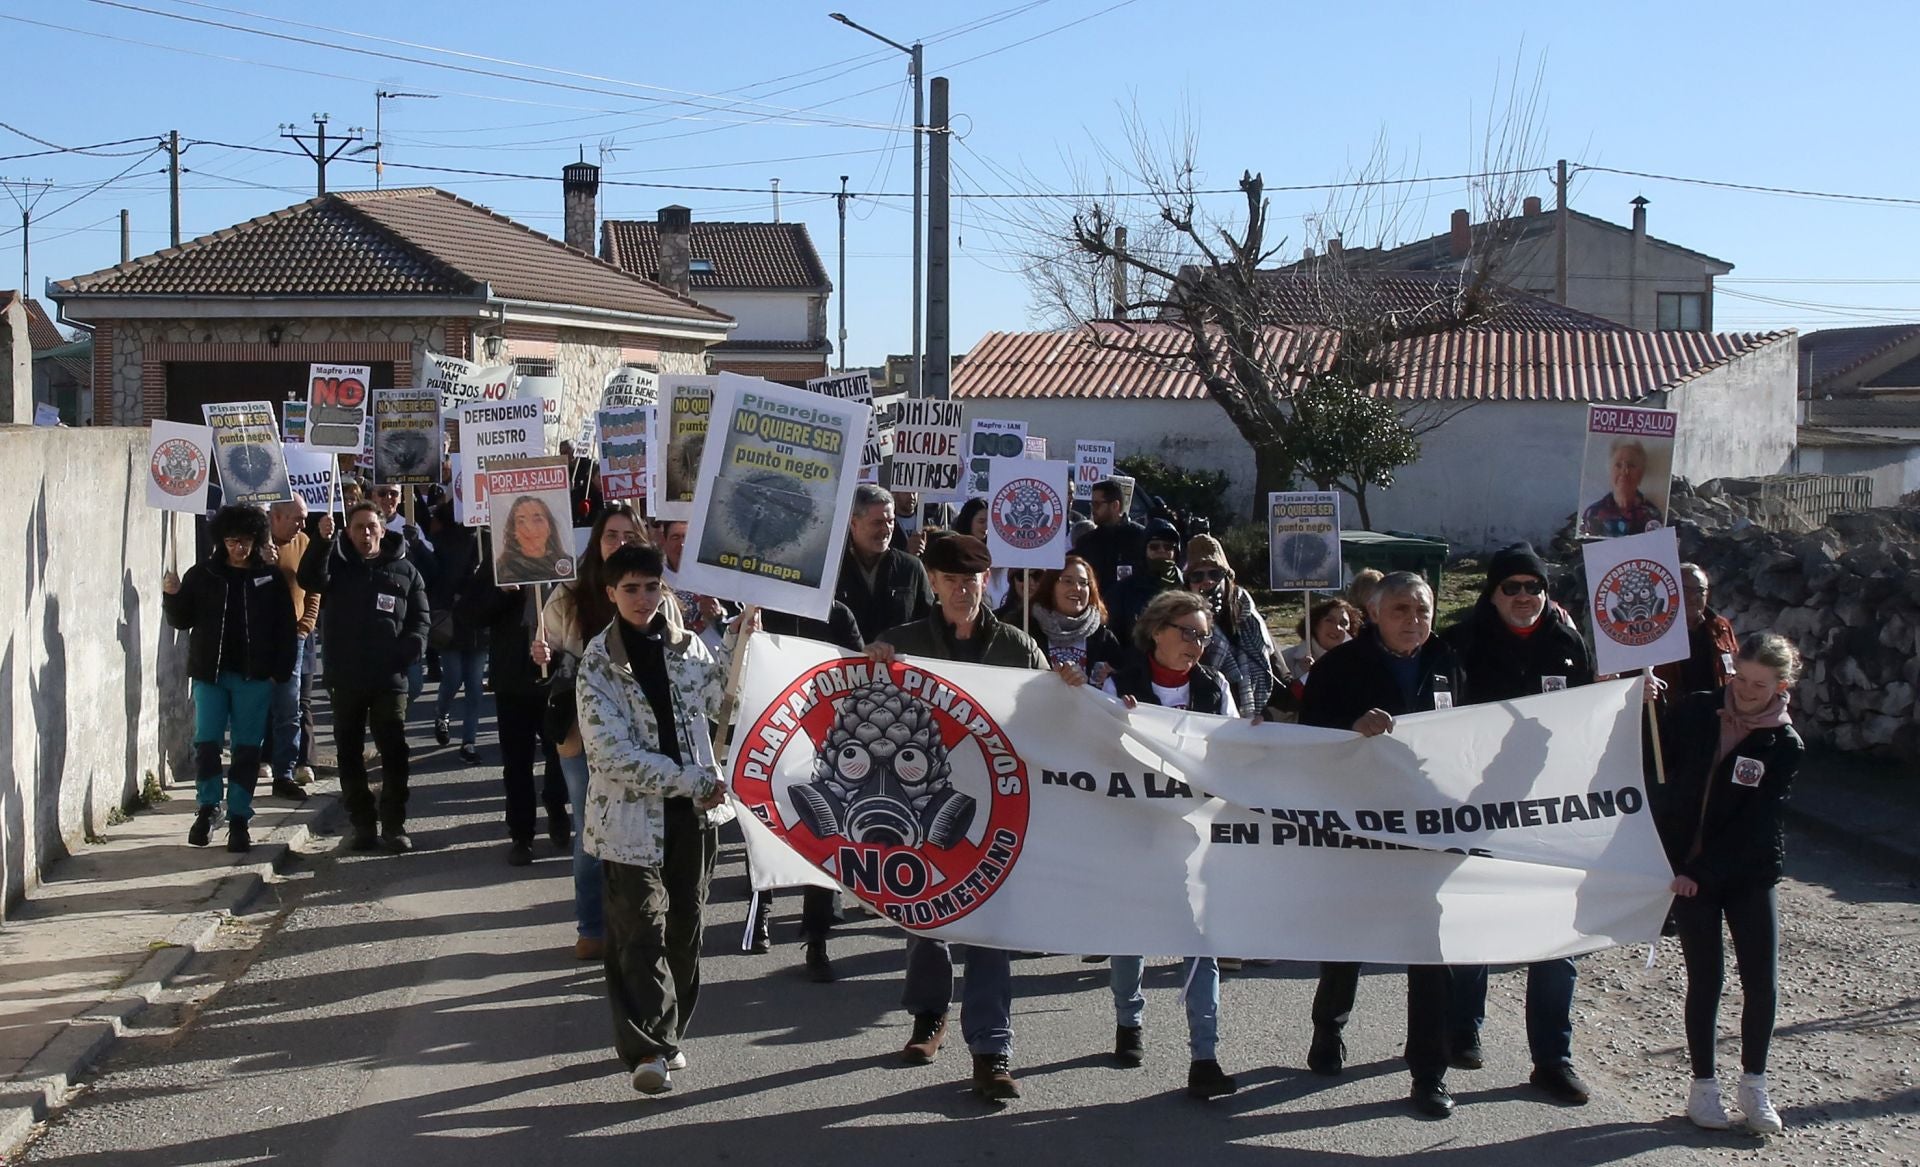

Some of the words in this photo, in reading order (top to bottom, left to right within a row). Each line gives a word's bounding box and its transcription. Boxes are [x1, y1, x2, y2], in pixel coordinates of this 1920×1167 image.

[312, 377, 365, 407] NO
[379, 390, 434, 400] Pinarejos
[482, 383, 506, 399] NO
[209, 403, 266, 414] Pinarejos
[378, 400, 390, 413] NO
[420, 400, 436, 412] SER
[464, 404, 537, 424] DEFENDEMOS
[675, 398, 690, 413] NO
[742, 393, 842, 426] Pinarejos
[210, 414, 224, 428] NO
[254, 412, 270, 427] SER
[1593, 410, 1617, 426] POR
[1620, 412, 1634, 428] LA
[1636, 413, 1673, 431] SALUD
[220, 433, 245, 445] punto
[247, 433, 272, 443] negro
[477, 429, 526, 446] NUESTRO
[736, 411, 758, 433] NO
[760, 416, 811, 446] QUIERE
[812, 426, 842, 453] SER
[776, 443, 793, 456] un
[896, 431, 958, 456] ALCALDE
[973, 432, 1023, 457] NO
[1078, 444, 1111, 453] NUESTRA
[735, 446, 781, 469] punto
[785, 457, 830, 480] negro
[1083, 456, 1107, 464] SALUD
[289, 471, 331, 486] SALUD
[491, 473, 513, 489] POR
[514, 472, 528, 487] LA
[530, 469, 565, 486] SALUD
[1080, 465, 1098, 482] NO
[993, 480, 1032, 513] PLATAFORMA
[1275, 494, 1332, 503] Pinarejos
[1274, 505, 1286, 517] NO
[1287, 504, 1317, 518] QUIERE
[1318, 504, 1334, 516] SER
[1016, 529, 1036, 539] NO
[1277, 523, 1304, 534] punto
[1305, 523, 1332, 534] negro
[720, 553, 738, 566] en
[742, 557, 756, 570] el
[760, 560, 801, 581] mapa
[1597, 561, 1638, 611] PLATAFORMA
[1640, 561, 1677, 597] PINAREJOS
[1629, 620, 1652, 635] NO
[743, 661, 892, 783] PLATAFORMA
[1042, 769, 1096, 792] NO
[1106, 772, 1136, 798] A
[1144, 772, 1193, 798] LA
[1354, 810, 1407, 834] DE
[1415, 786, 1643, 835] BIOMETANO
[1210, 823, 1259, 845] EN
[839, 846, 928, 897] NO
[884, 828, 1019, 926] BIOMETANO
